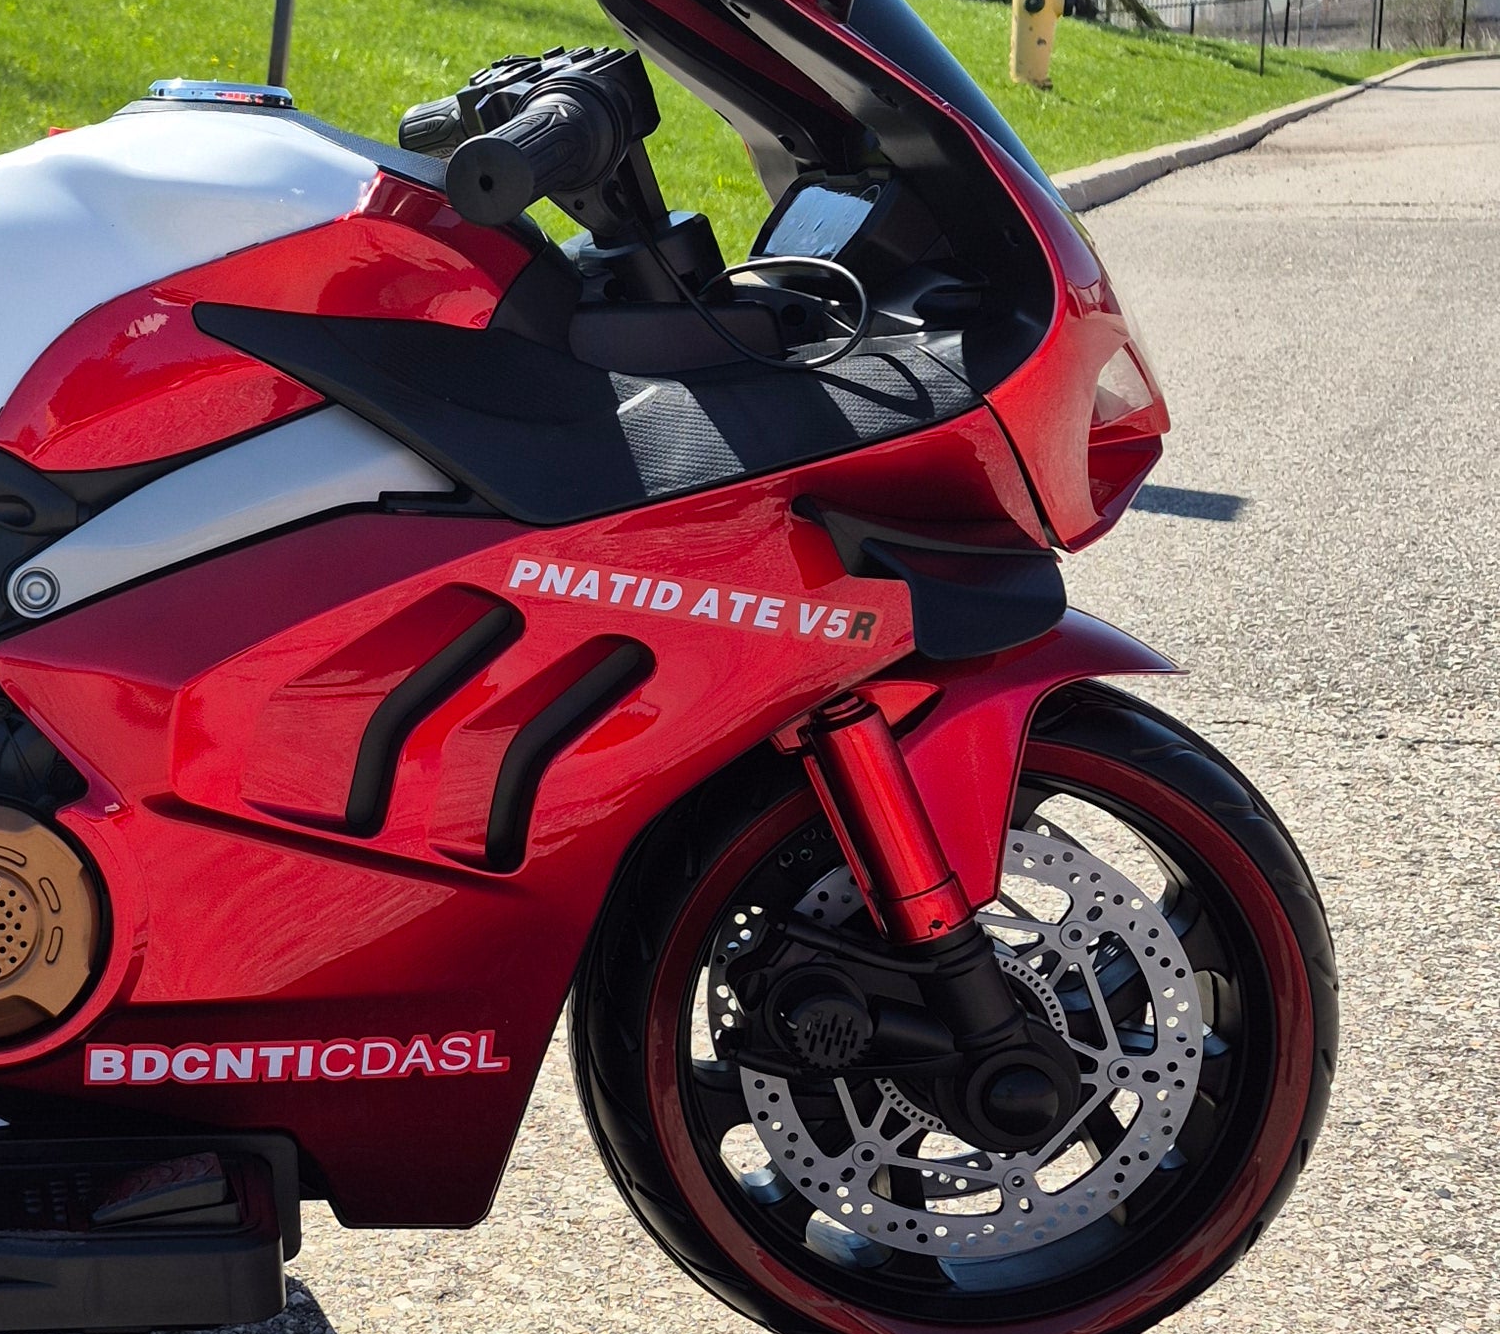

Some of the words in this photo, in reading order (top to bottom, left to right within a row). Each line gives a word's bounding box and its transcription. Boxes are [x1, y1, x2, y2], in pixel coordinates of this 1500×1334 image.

[508, 559, 683, 611] PNATID
[689, 588, 786, 630] ATE
[798, 602, 878, 642] V5R
[89, 1034, 504, 1082] BDCNTICDASL
